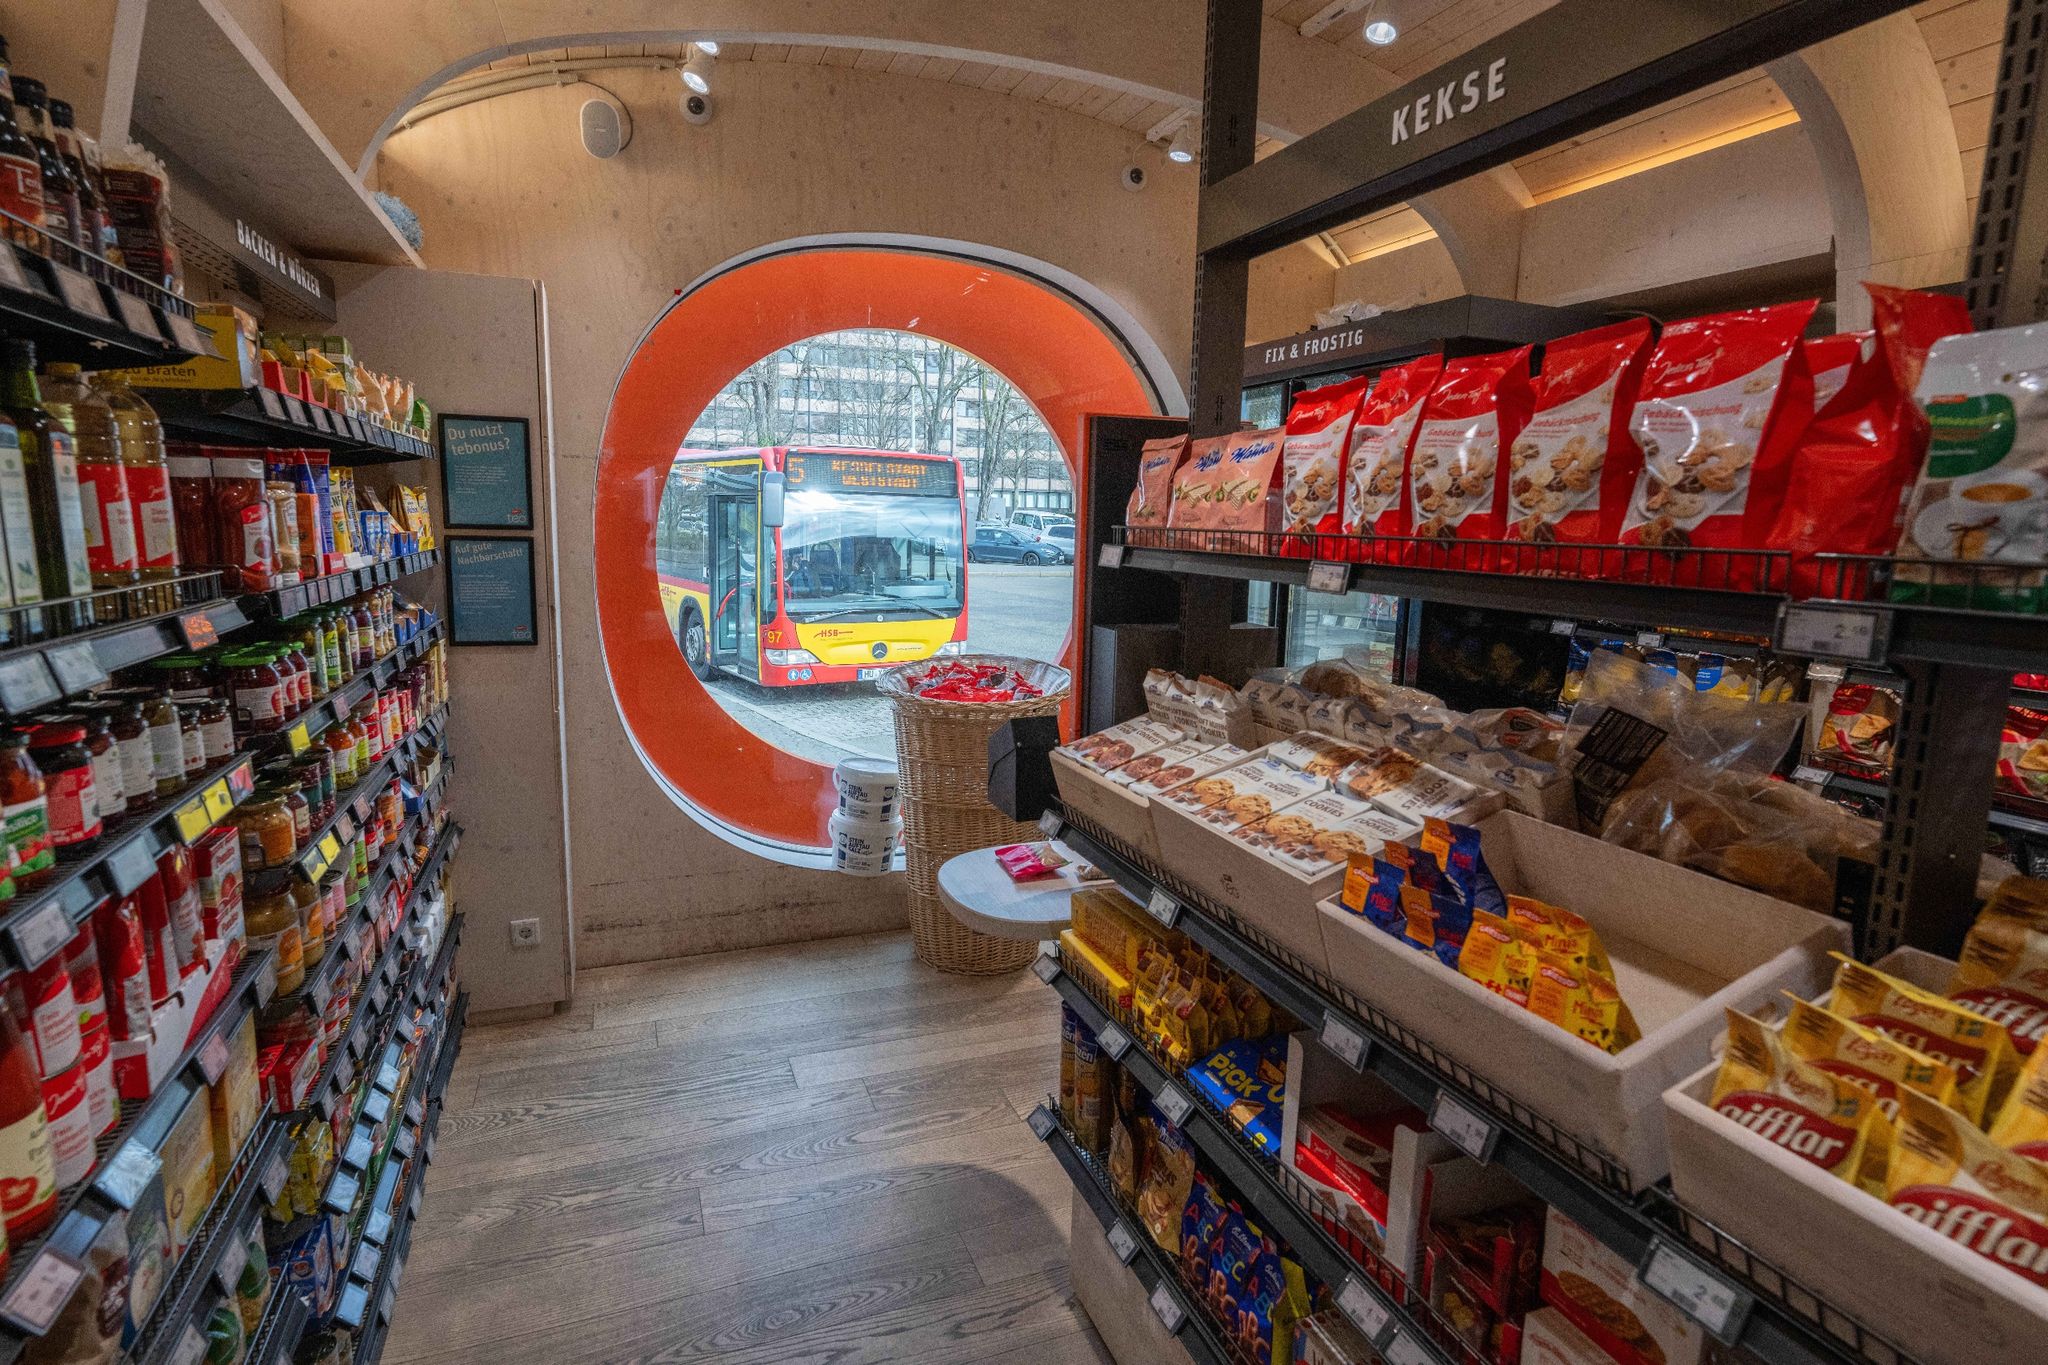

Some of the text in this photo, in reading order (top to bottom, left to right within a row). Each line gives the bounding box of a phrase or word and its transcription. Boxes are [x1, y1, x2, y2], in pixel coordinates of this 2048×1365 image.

[1391, 56, 1507, 146] KEKSE
[236, 218, 321, 299] BACKEN & WÜRZEN
[1265, 329, 1363, 364] FIX & FROSTIG
[447, 423, 504, 441] Du nutzt
[451, 437, 510, 456] tebonus?
[787, 457, 805, 483] 5
[455, 542, 493, 554] Auf gute
[457, 547, 524, 566] Nachbarschaft!
[1264, 781, 1301, 797] COOKIES
[1303, 799, 1345, 818] COOKIES
[1353, 818, 1399, 837] COOKIES
